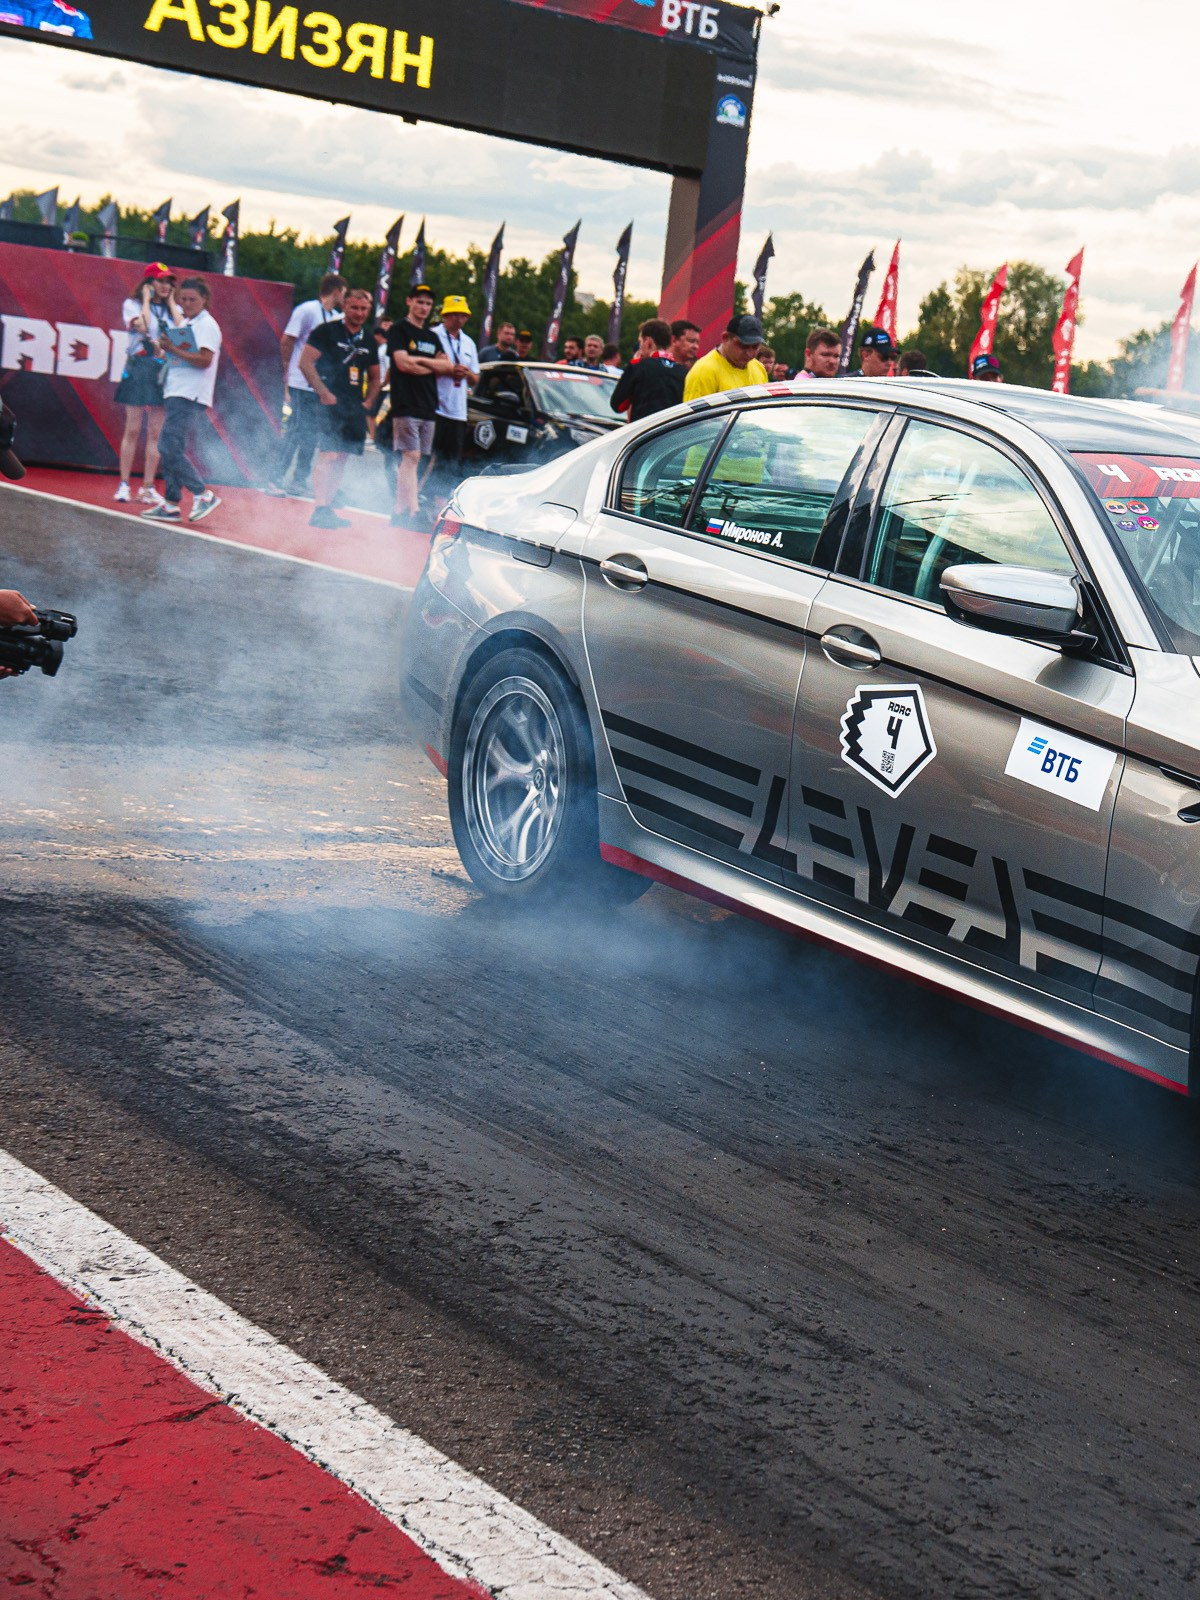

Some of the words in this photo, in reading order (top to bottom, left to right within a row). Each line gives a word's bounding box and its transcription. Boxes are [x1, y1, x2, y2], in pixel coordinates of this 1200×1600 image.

[661, 0, 720, 40] ВТБ
[144, 0, 434, 89] АЗИЗЯН
[721, 520, 772, 545] Миронов
[770, 531, 784, 548] А.
[887, 700, 912, 717] RDRC
[886, 715, 903, 750] 4
[1040, 747, 1083, 784] ВТБ
